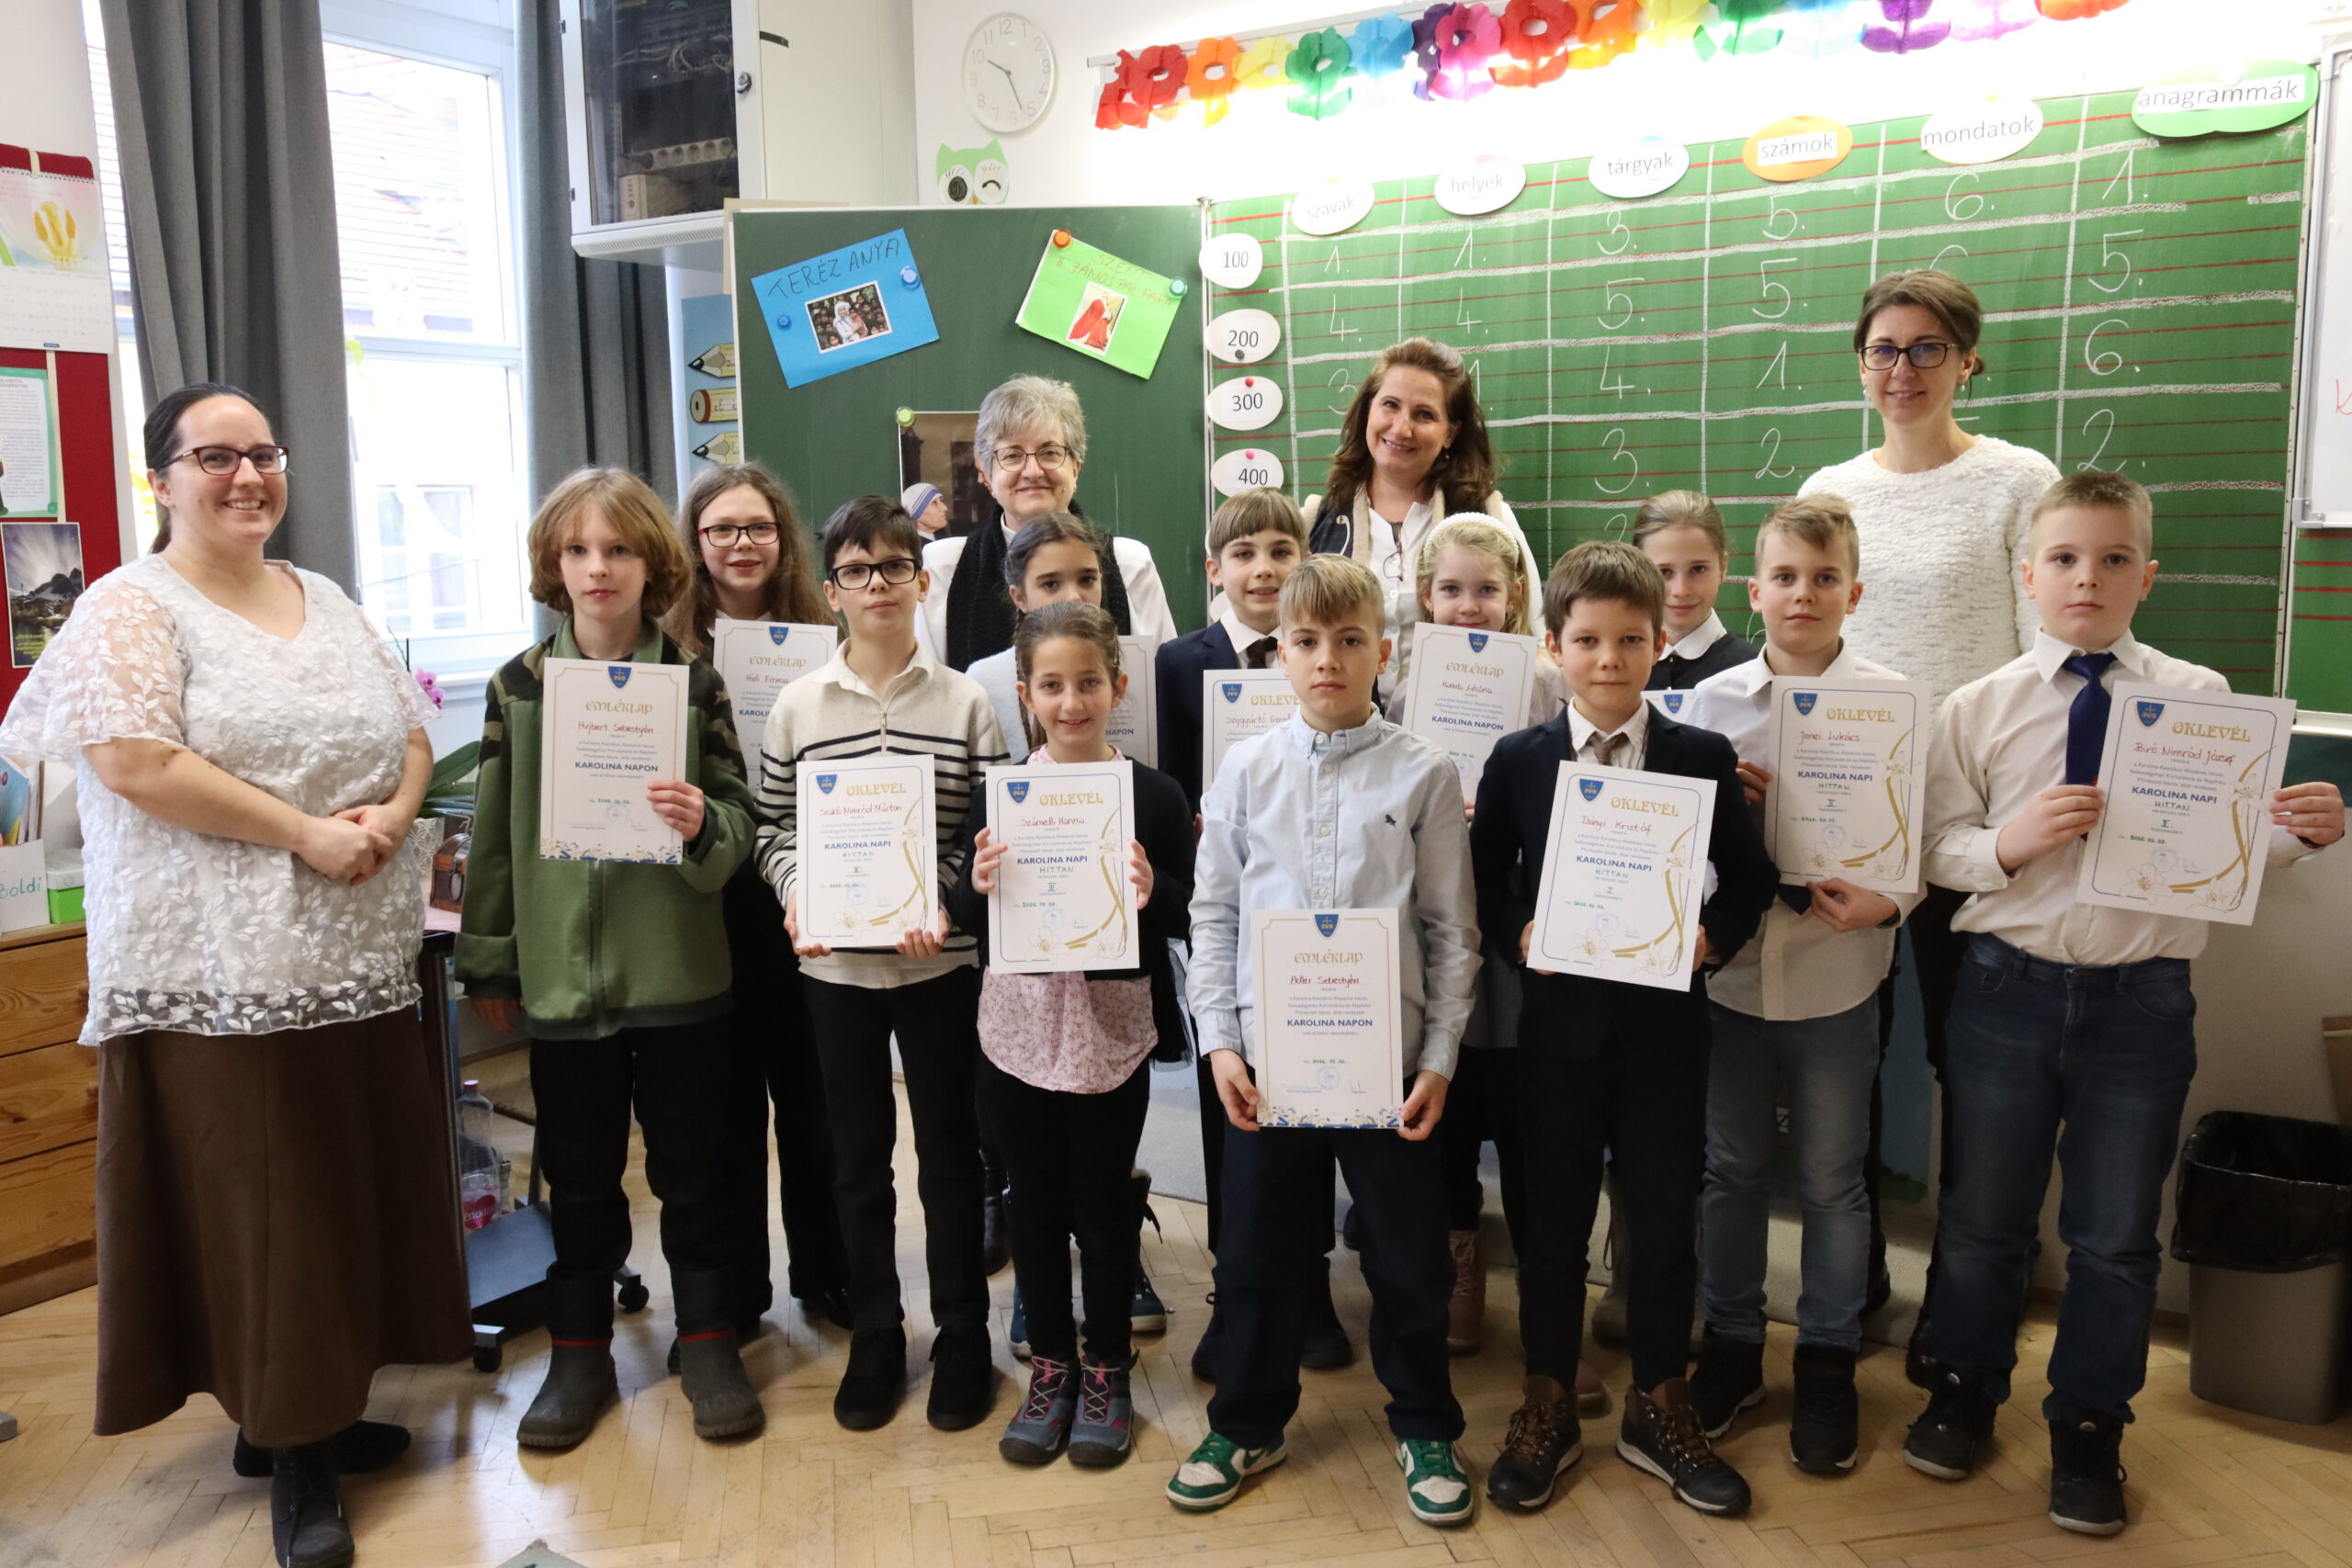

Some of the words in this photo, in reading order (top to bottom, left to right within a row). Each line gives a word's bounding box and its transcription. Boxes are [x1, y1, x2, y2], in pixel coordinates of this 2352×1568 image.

[998, 18, 1012, 35] 12
[1021, 21, 1027, 38] 1
[982, 29, 994, 45] 11
[1034, 36, 1044, 52] 2
[971, 49, 985, 64] 10
[1042, 58, 1051, 74] 3
[969, 72, 978, 86] 9
[1038, 84, 1047, 96] 4
[2139, 80, 2299, 111] anagrammák
[977, 94, 986, 108] 8
[1026, 101, 1036, 117] 5
[991, 107, 1001, 122] 7
[1010, 111, 1018, 125] 6
[1924, 115, 2035, 148] mondatok
[1761, 134, 1834, 159] számok
[1607, 152, 1673, 176] tárgyak
[1451, 173, 1504, 195] helyek
[1307, 197, 1355, 220] szavak
[1222, 251, 1249, 268] 100
[768, 259, 842, 299] TERÉZ
[850, 238, 899, 272] ANYA
[1227, 329, 1259, 347] 200
[1231, 392, 1263, 412] 300
[1238, 468, 1268, 485] 400
[1431, 716, 1473, 727] KAROLINA
[1475, 720, 1504, 731] NAPON
[1826, 708, 1896, 723] OKLEVÉL
[2172, 721, 2251, 742] OKLEVÉL
[575, 761, 622, 771] KAROLINA
[625, 763, 658, 773] NAPON
[1797, 771, 1847, 781] KAROLINA
[1849, 773, 1873, 782] NAPI
[846, 783, 907, 796] OKLEVÉL
[2132, 786, 2188, 800] KAROLINA
[2190, 794, 2218, 804] NAPI
[1039, 790, 1103, 807] OKLEVÉL
[1611, 796, 1679, 817] OKLEVÉL
[2154, 801, 2190, 811] HITTAN
[824, 841, 868, 850] KAROLINA
[1017, 855, 1064, 864] KAROLINA
[1066, 855, 1088, 863] NAPI
[1577, 855, 1626, 868] KAROLINA
[1629, 862, 1652, 872] NAPI
[1040, 865, 1074, 874] HITTAN
[1595, 869, 1629, 879] HITTAN
[1287, 1019, 1335, 1027] KAROLINA
[1338, 1019, 1373, 1027] NAPON
